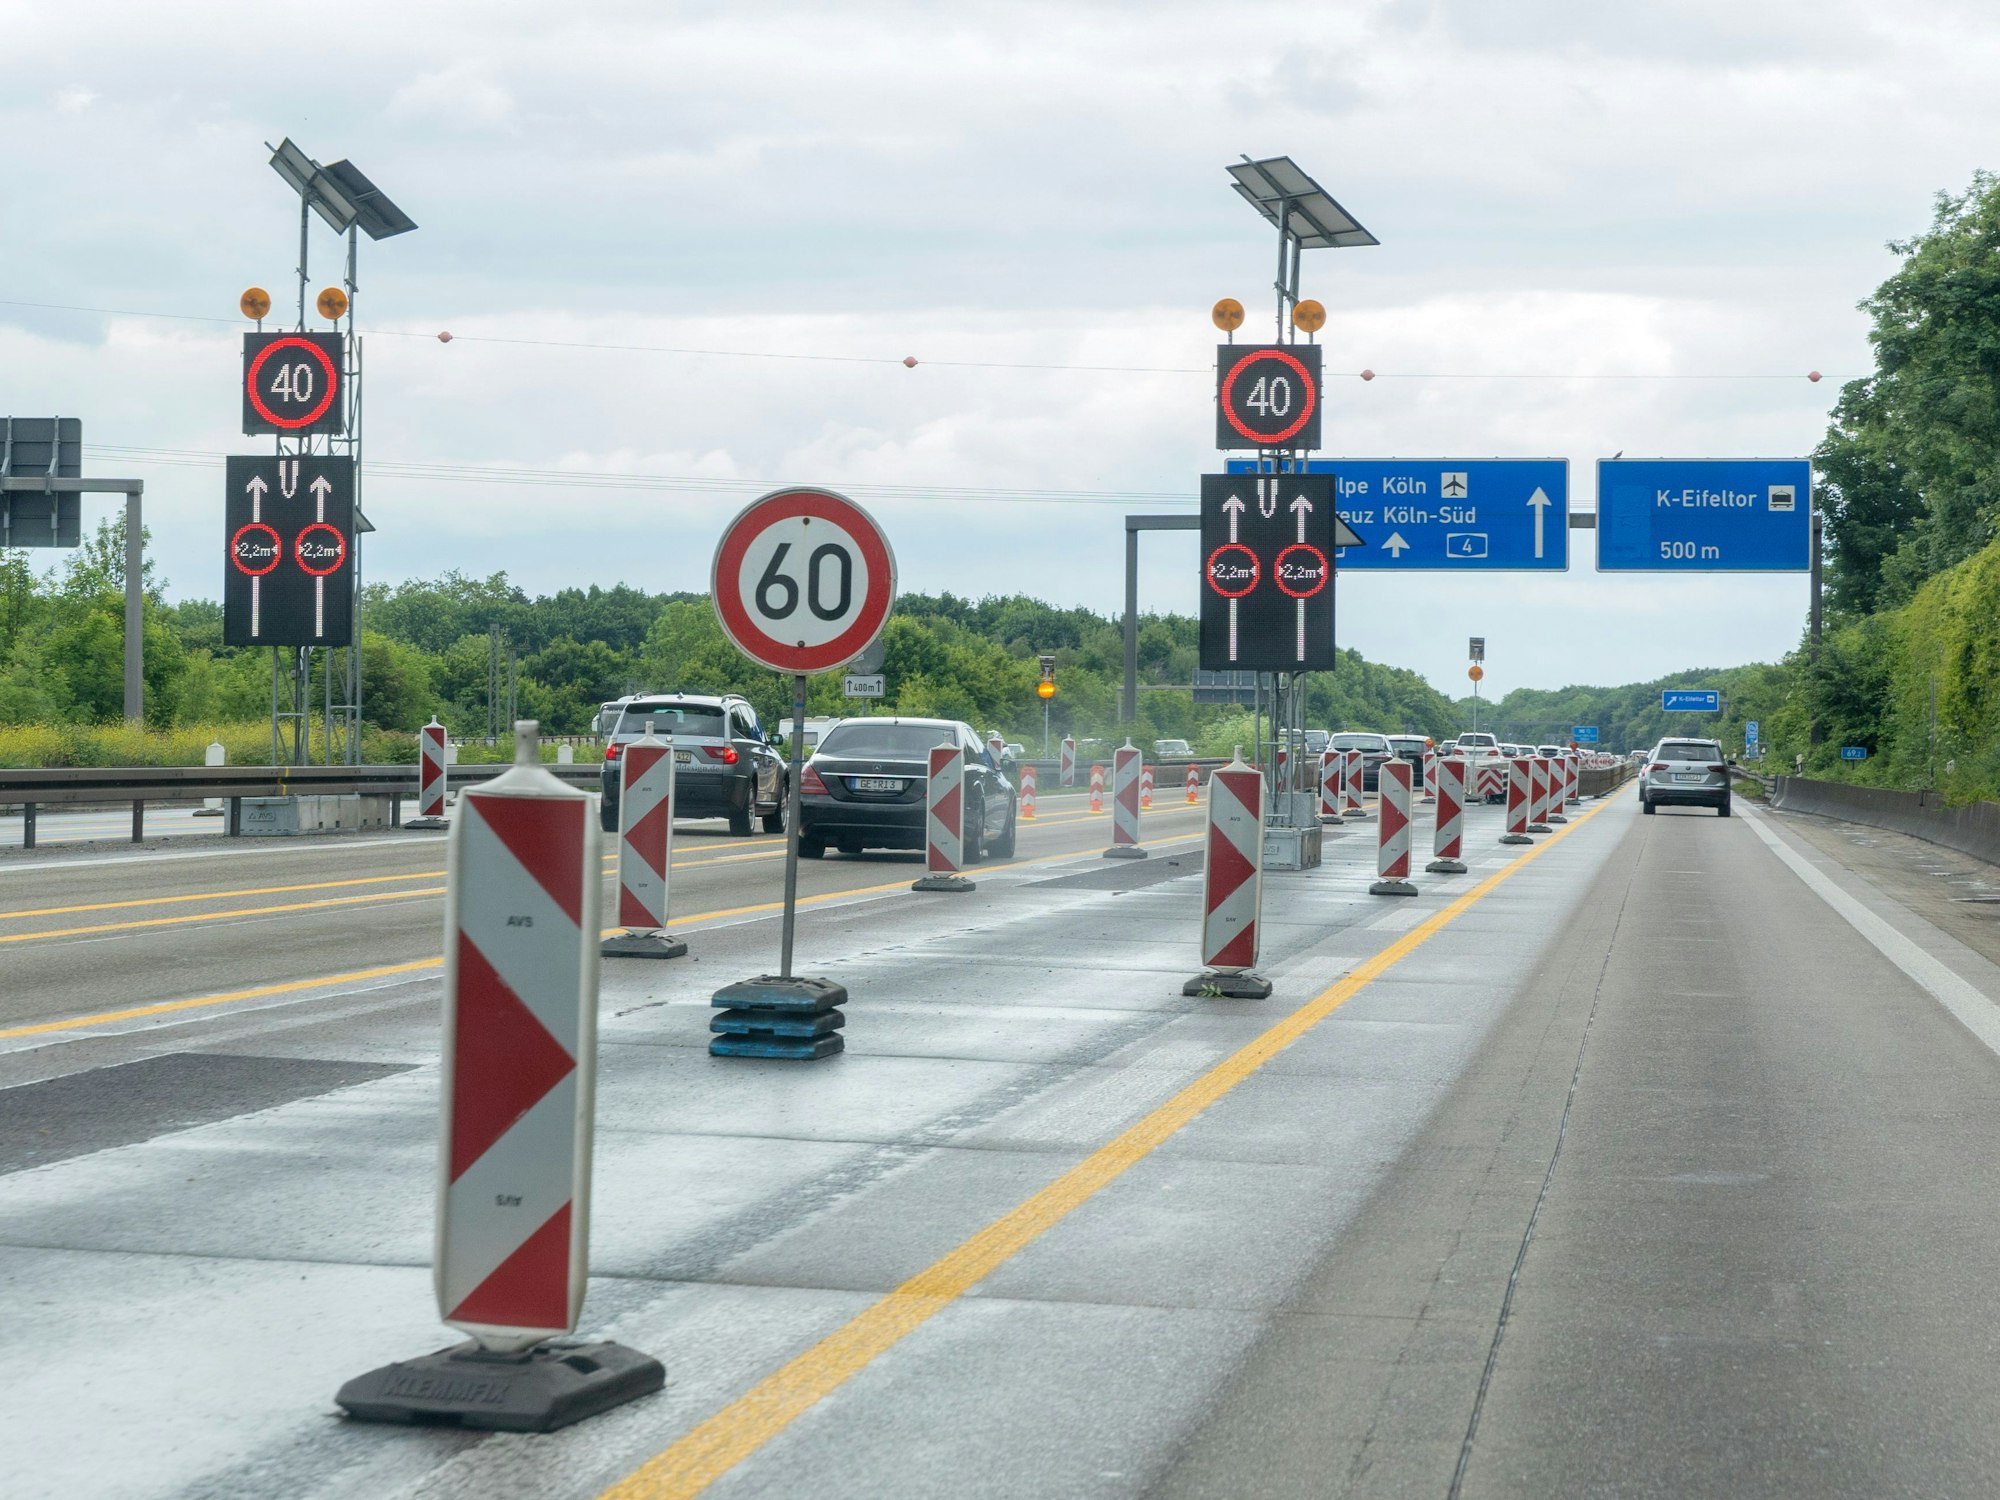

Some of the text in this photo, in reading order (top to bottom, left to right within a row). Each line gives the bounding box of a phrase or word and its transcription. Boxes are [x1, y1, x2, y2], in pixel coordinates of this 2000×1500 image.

[270, 363, 313, 402] 40
[1246, 376, 1291, 417] 40
[1382, 476, 1427, 494] Köln
[1656, 489, 1758, 507] K-Eifeltor
[1383, 506, 1476, 524] Köln-Süd
[1462, 538, 1473, 553] 4
[1660, 541, 1720, 559] 500 m
[755, 542, 852, 622] 60
[506, 915, 535, 928] AVS
